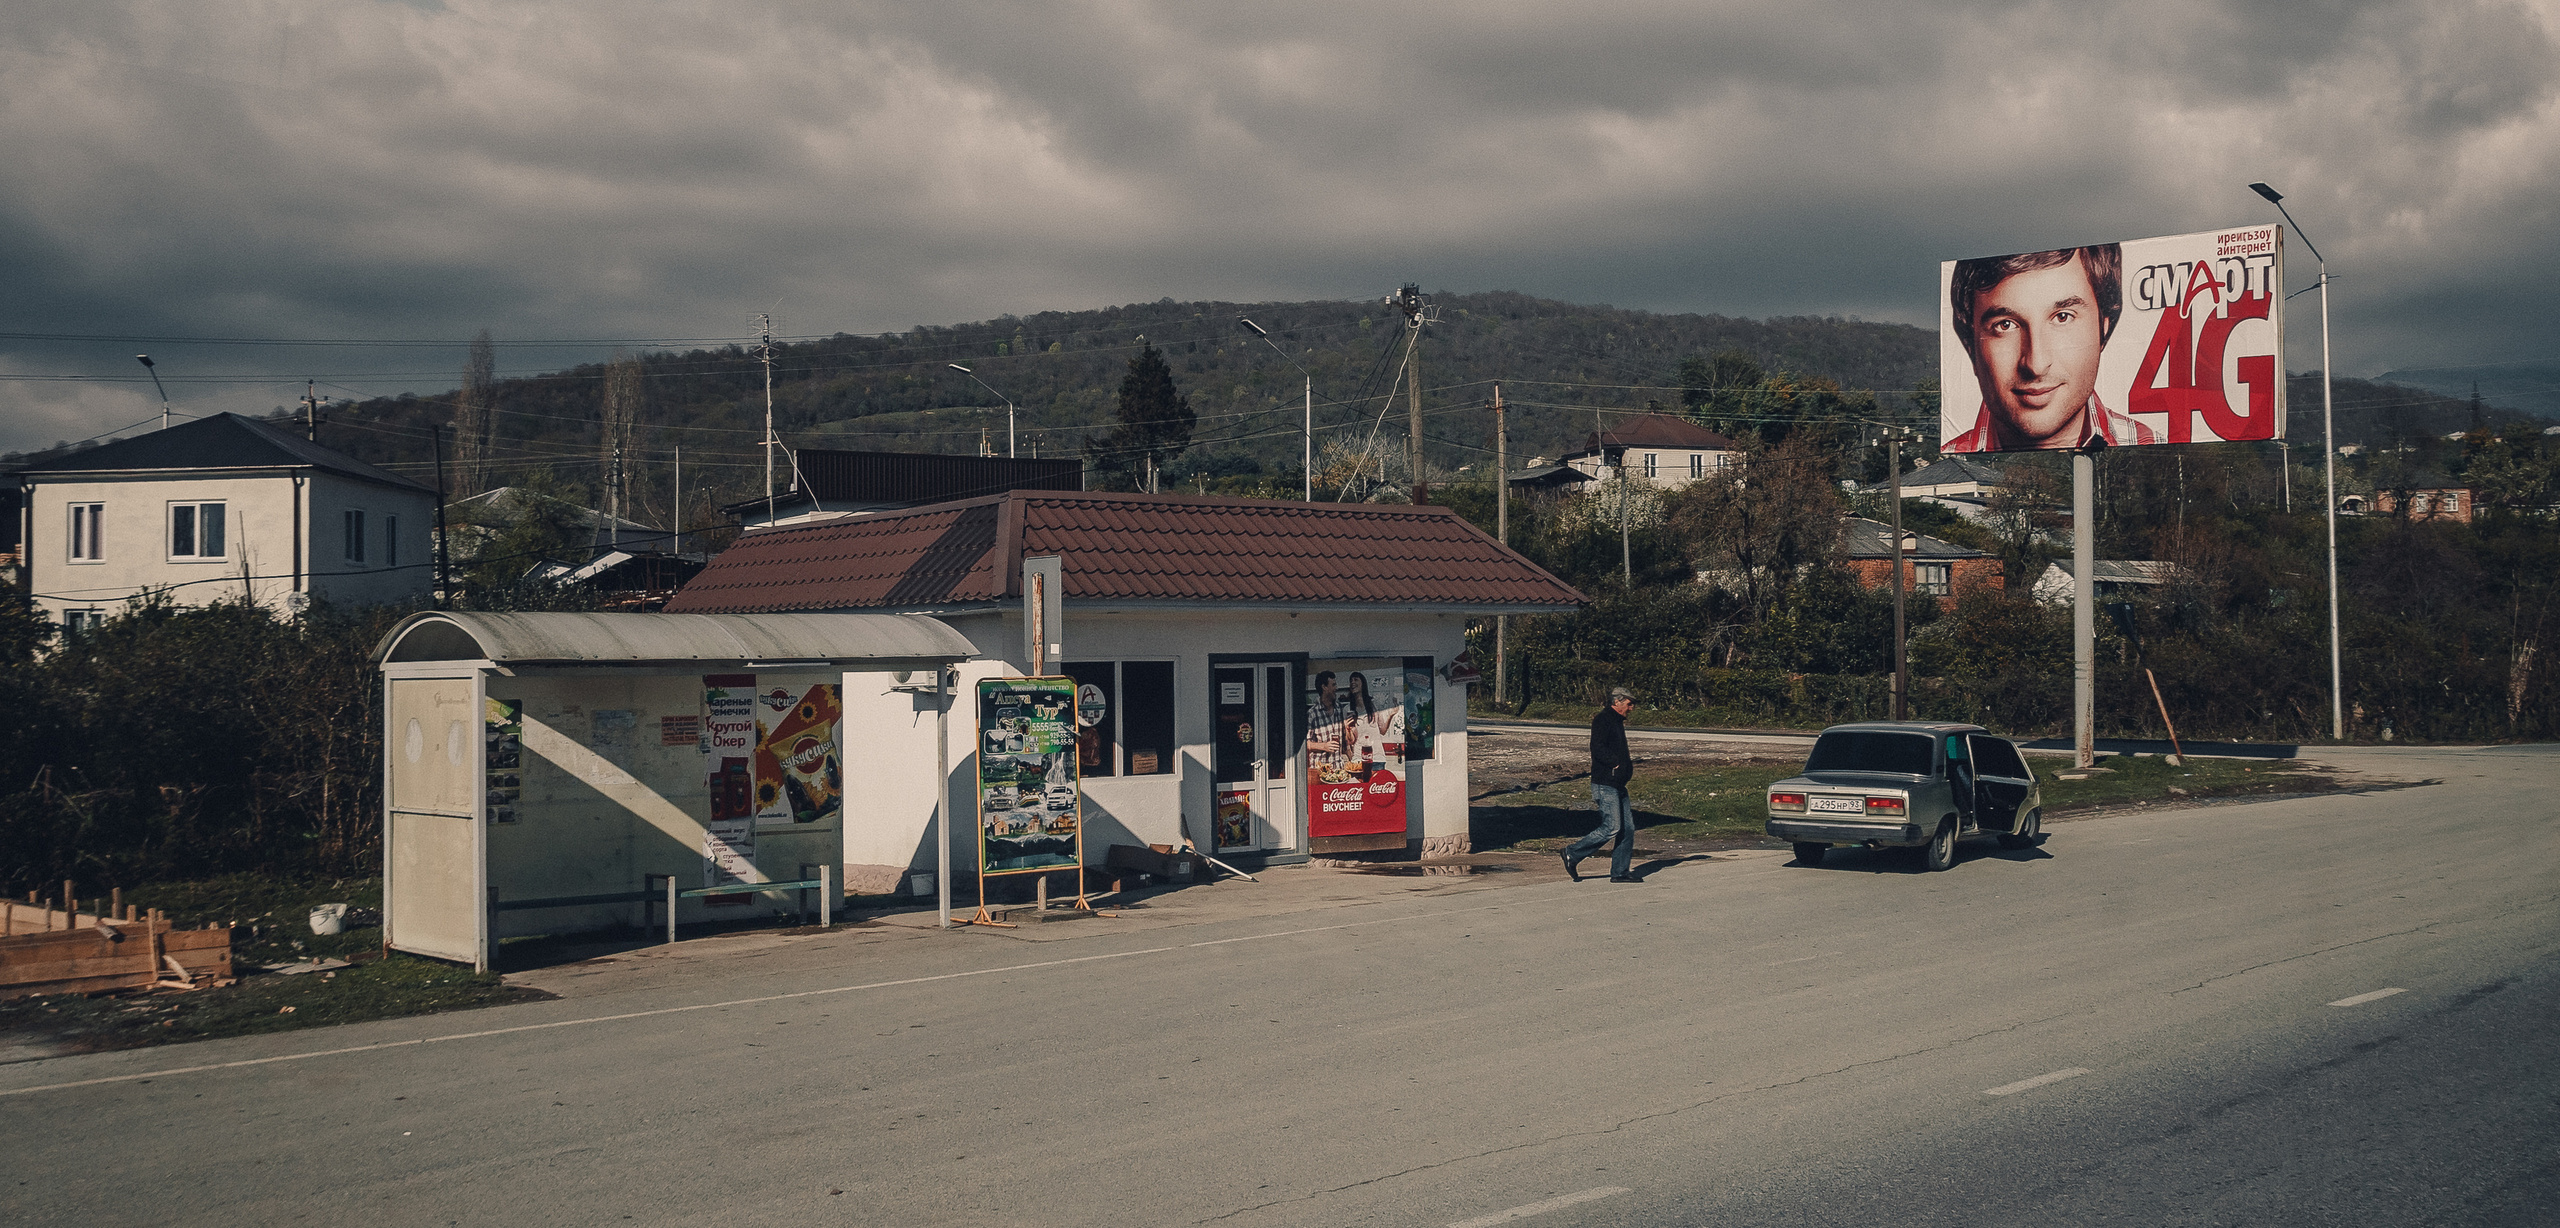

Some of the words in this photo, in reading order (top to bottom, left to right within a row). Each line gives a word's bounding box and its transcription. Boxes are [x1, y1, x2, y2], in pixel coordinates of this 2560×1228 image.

[2216, 241, 2272, 256] аинтернет
[2128, 290, 2275, 443] 4G
[711, 708, 751, 716] емечки
[706, 720, 752, 734] Крутой
[1031, 722, 1049, 732] 5555
[1369, 781, 1397, 794] Coca-Cola
[1329, 787, 1364, 802] Coca-Cola
[1849, 800, 1860, 808] 93
